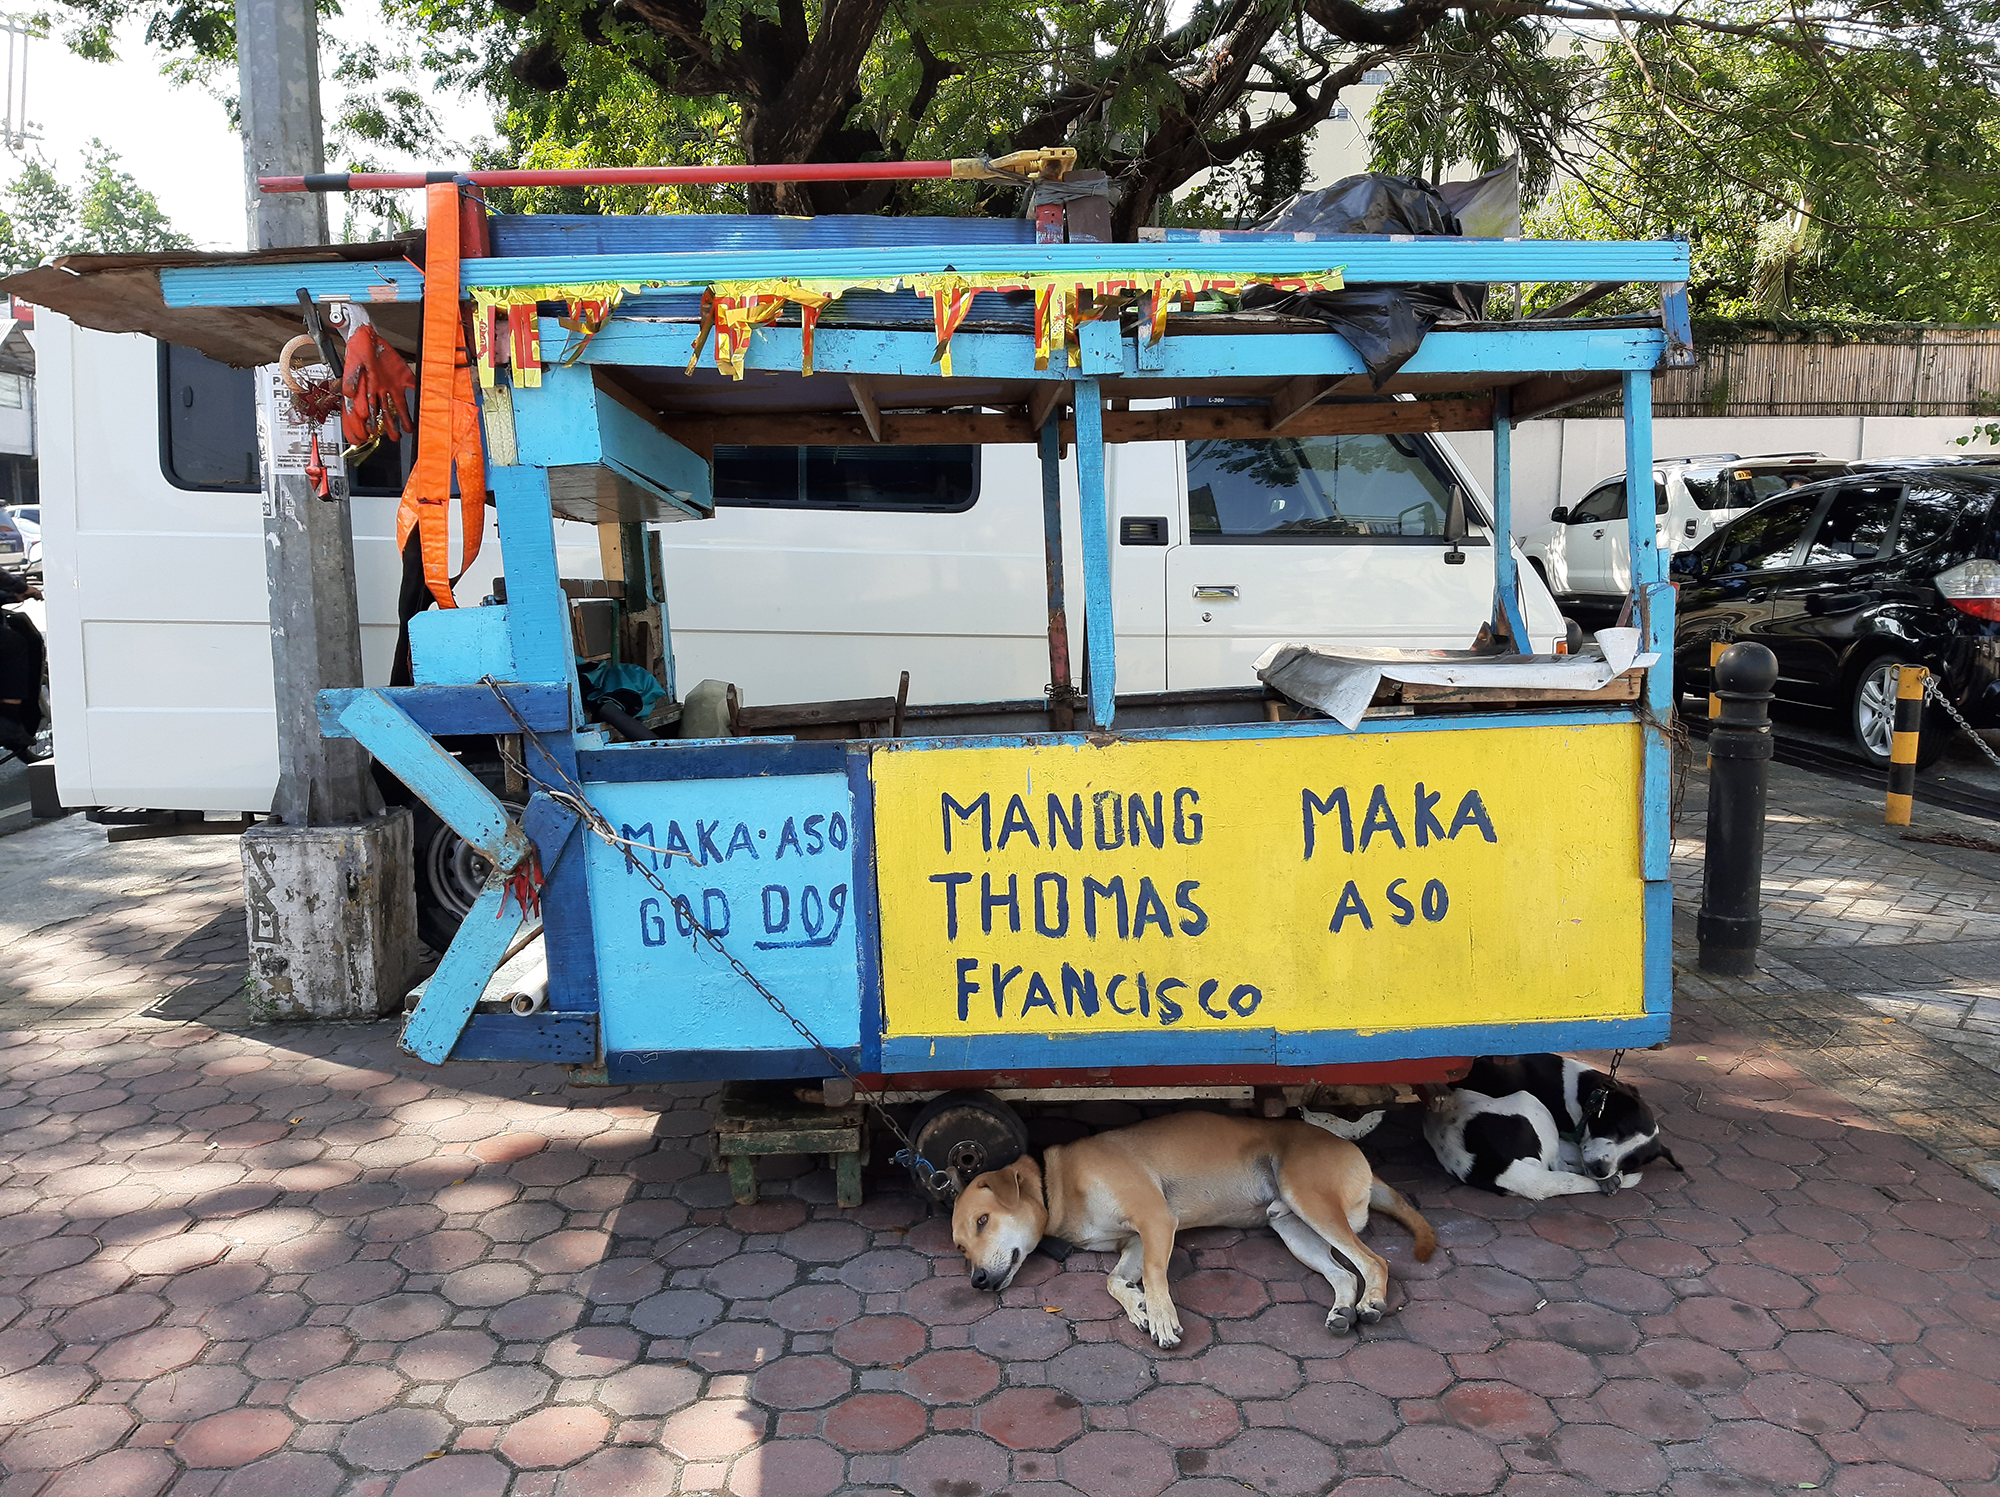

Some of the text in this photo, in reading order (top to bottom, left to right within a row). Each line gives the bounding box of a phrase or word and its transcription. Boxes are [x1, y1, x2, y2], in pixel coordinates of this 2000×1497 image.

[941, 787, 1203, 854] MANONG
[1302, 782, 1496, 860] MAKA
[640, 887, 731, 947] GOD
[929, 871, 1209, 941] THOMAS
[1329, 878, 1450, 934] ASO
